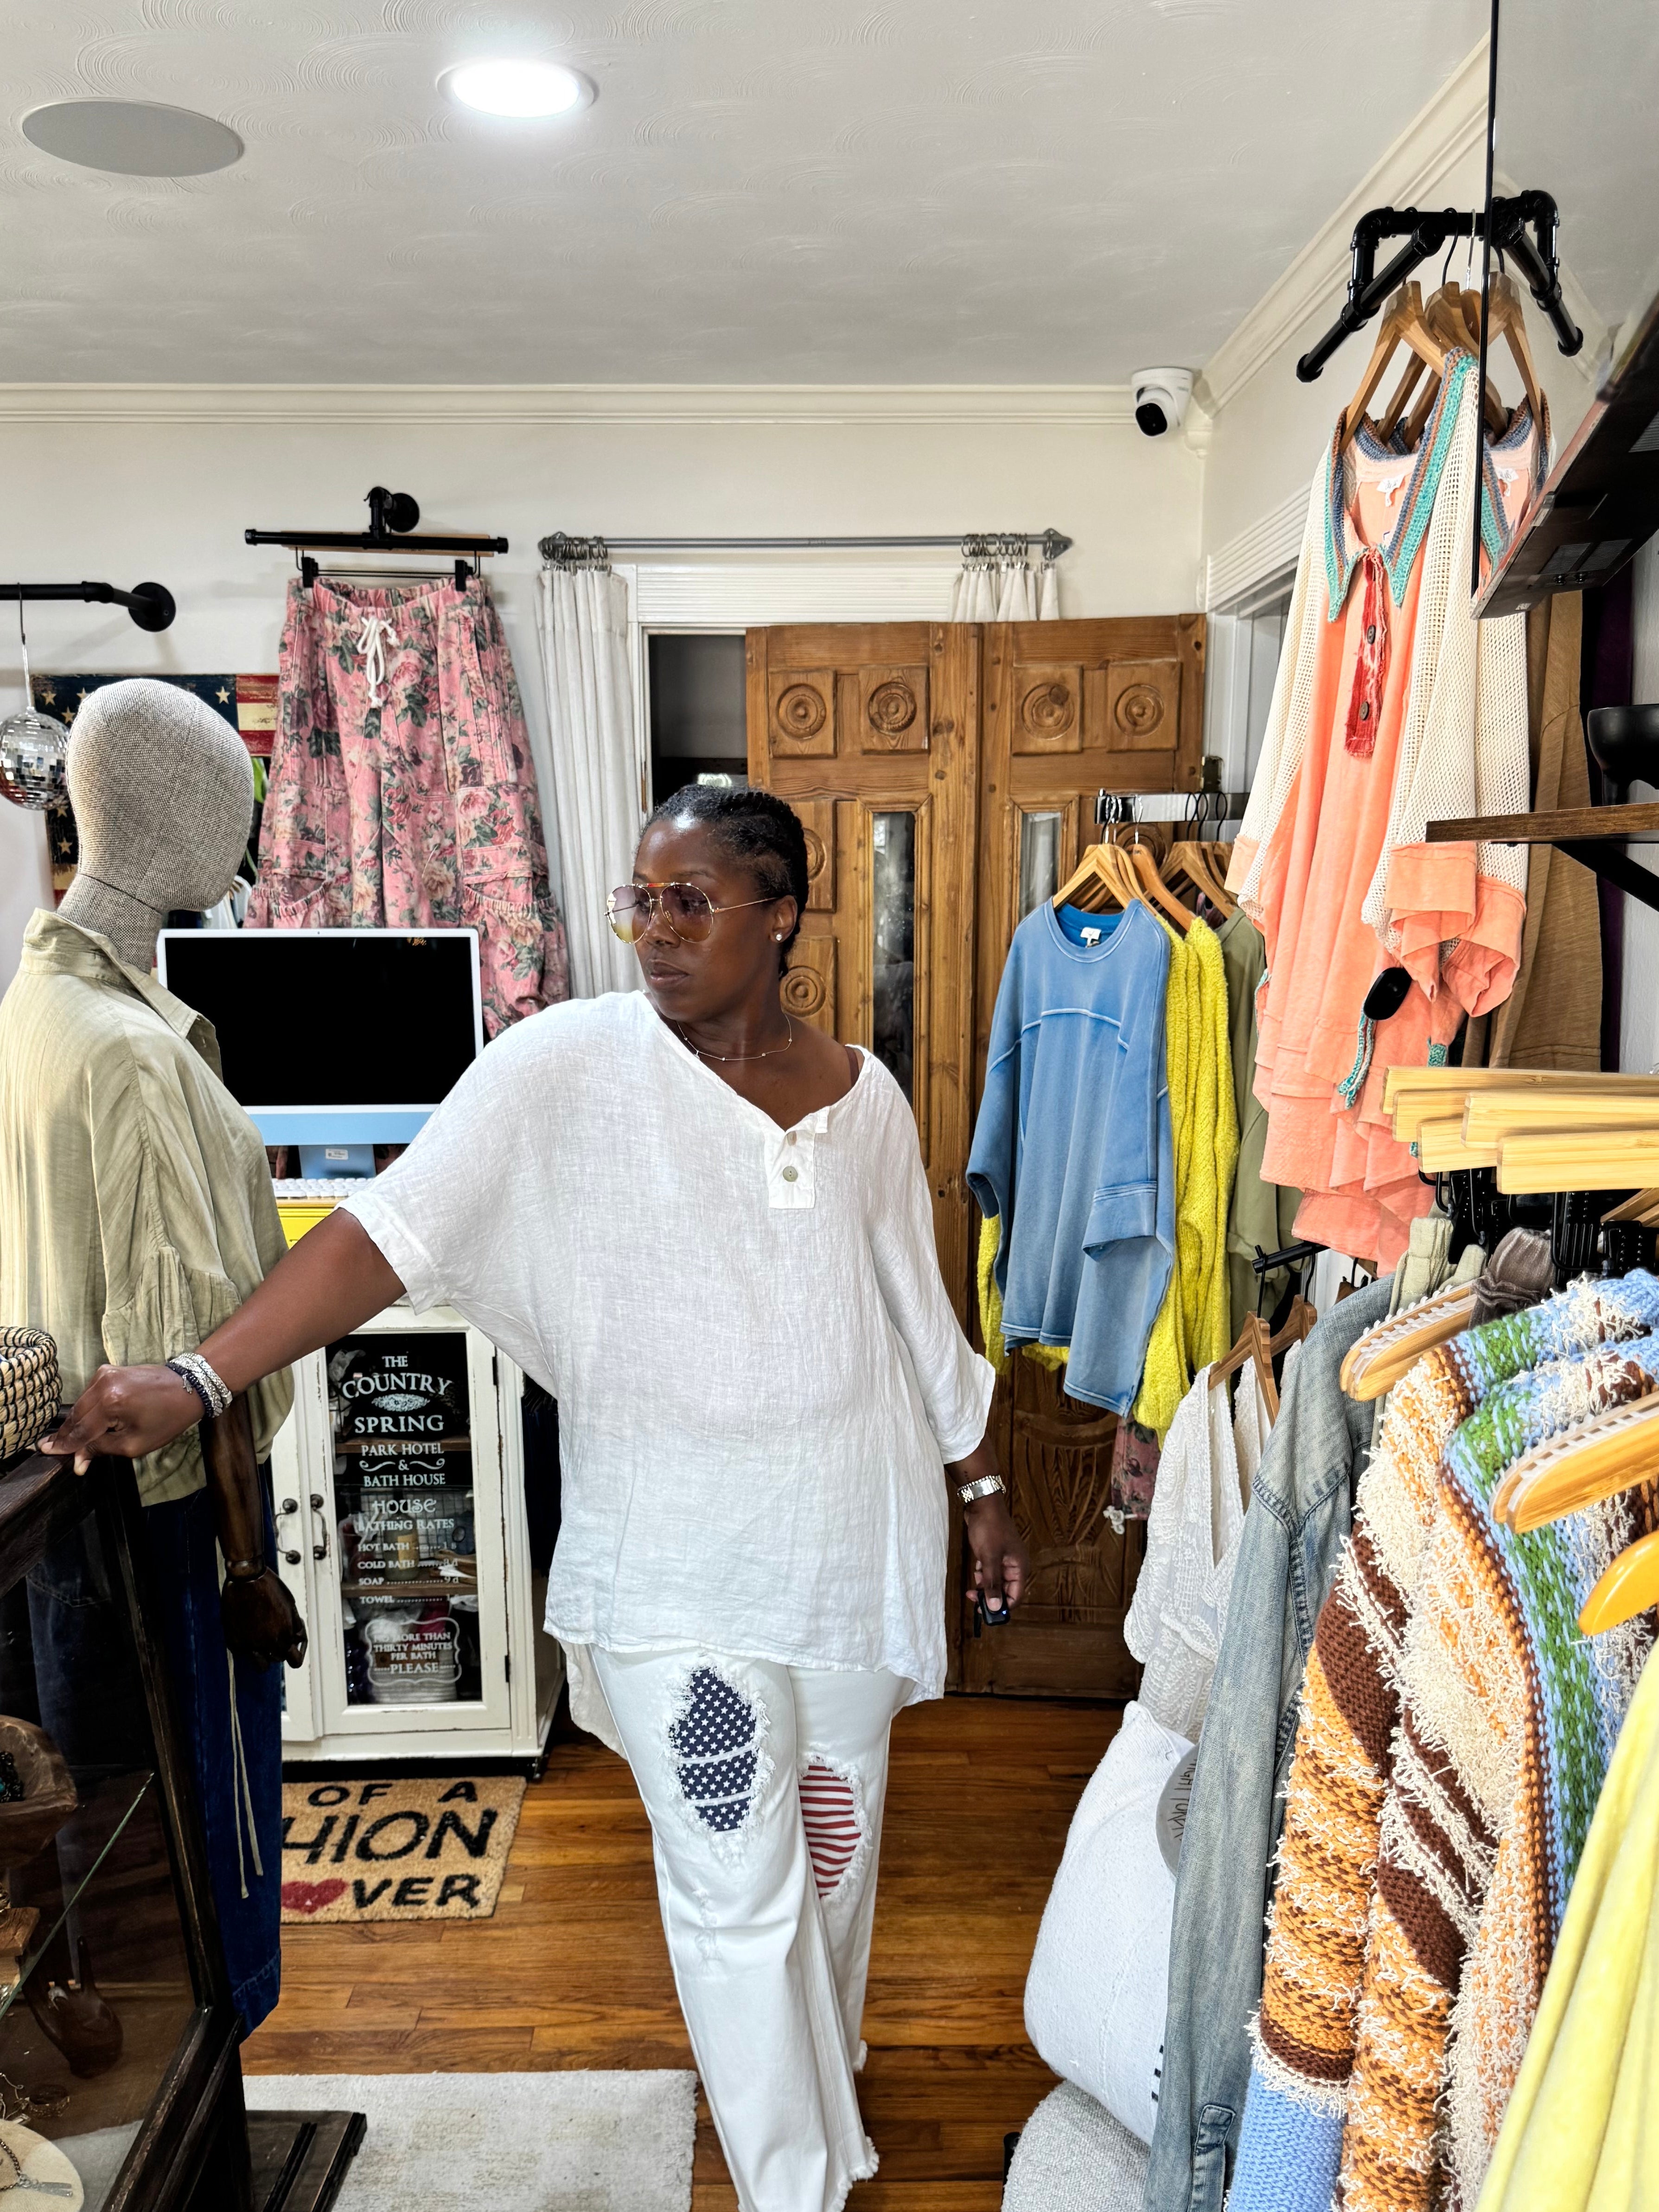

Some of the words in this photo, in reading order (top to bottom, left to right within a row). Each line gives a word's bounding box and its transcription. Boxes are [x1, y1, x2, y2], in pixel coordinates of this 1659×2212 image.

[382, 1356, 408, 1367] THE
[343, 1372, 452, 1399] COUNTRY
[355, 1415, 444, 1434] SPRING
[361, 1445, 397, 1456] PARK
[402, 1443, 444, 1455] HOTEL
[398, 1460, 409, 1471] &
[364, 1475, 399, 1487] BATH
[403, 1473, 446, 1486] HOUSE
[416, 1518, 454, 1530] RATES
[357, 1543, 381, 1552] HOT
[383, 1542, 409, 1551] BATH
[357, 1561, 386, 1569] COLD
[388, 1560, 415, 1568] BATH
[358, 1577, 384, 1586] SOAP
[359, 1595, 395, 1604] TOWEL
[422, 1632, 451, 1640] THAN
[373, 1644, 408, 1652] THIRTY
[411, 1642, 453, 1651] MINUTES
[390, 1652, 408, 1661] PER
[410, 1651, 436, 1660] BATH
[389, 1663, 439, 1674] PLEASE
[308, 1783, 392, 1806] OF
[437, 1781, 478, 1803] A
